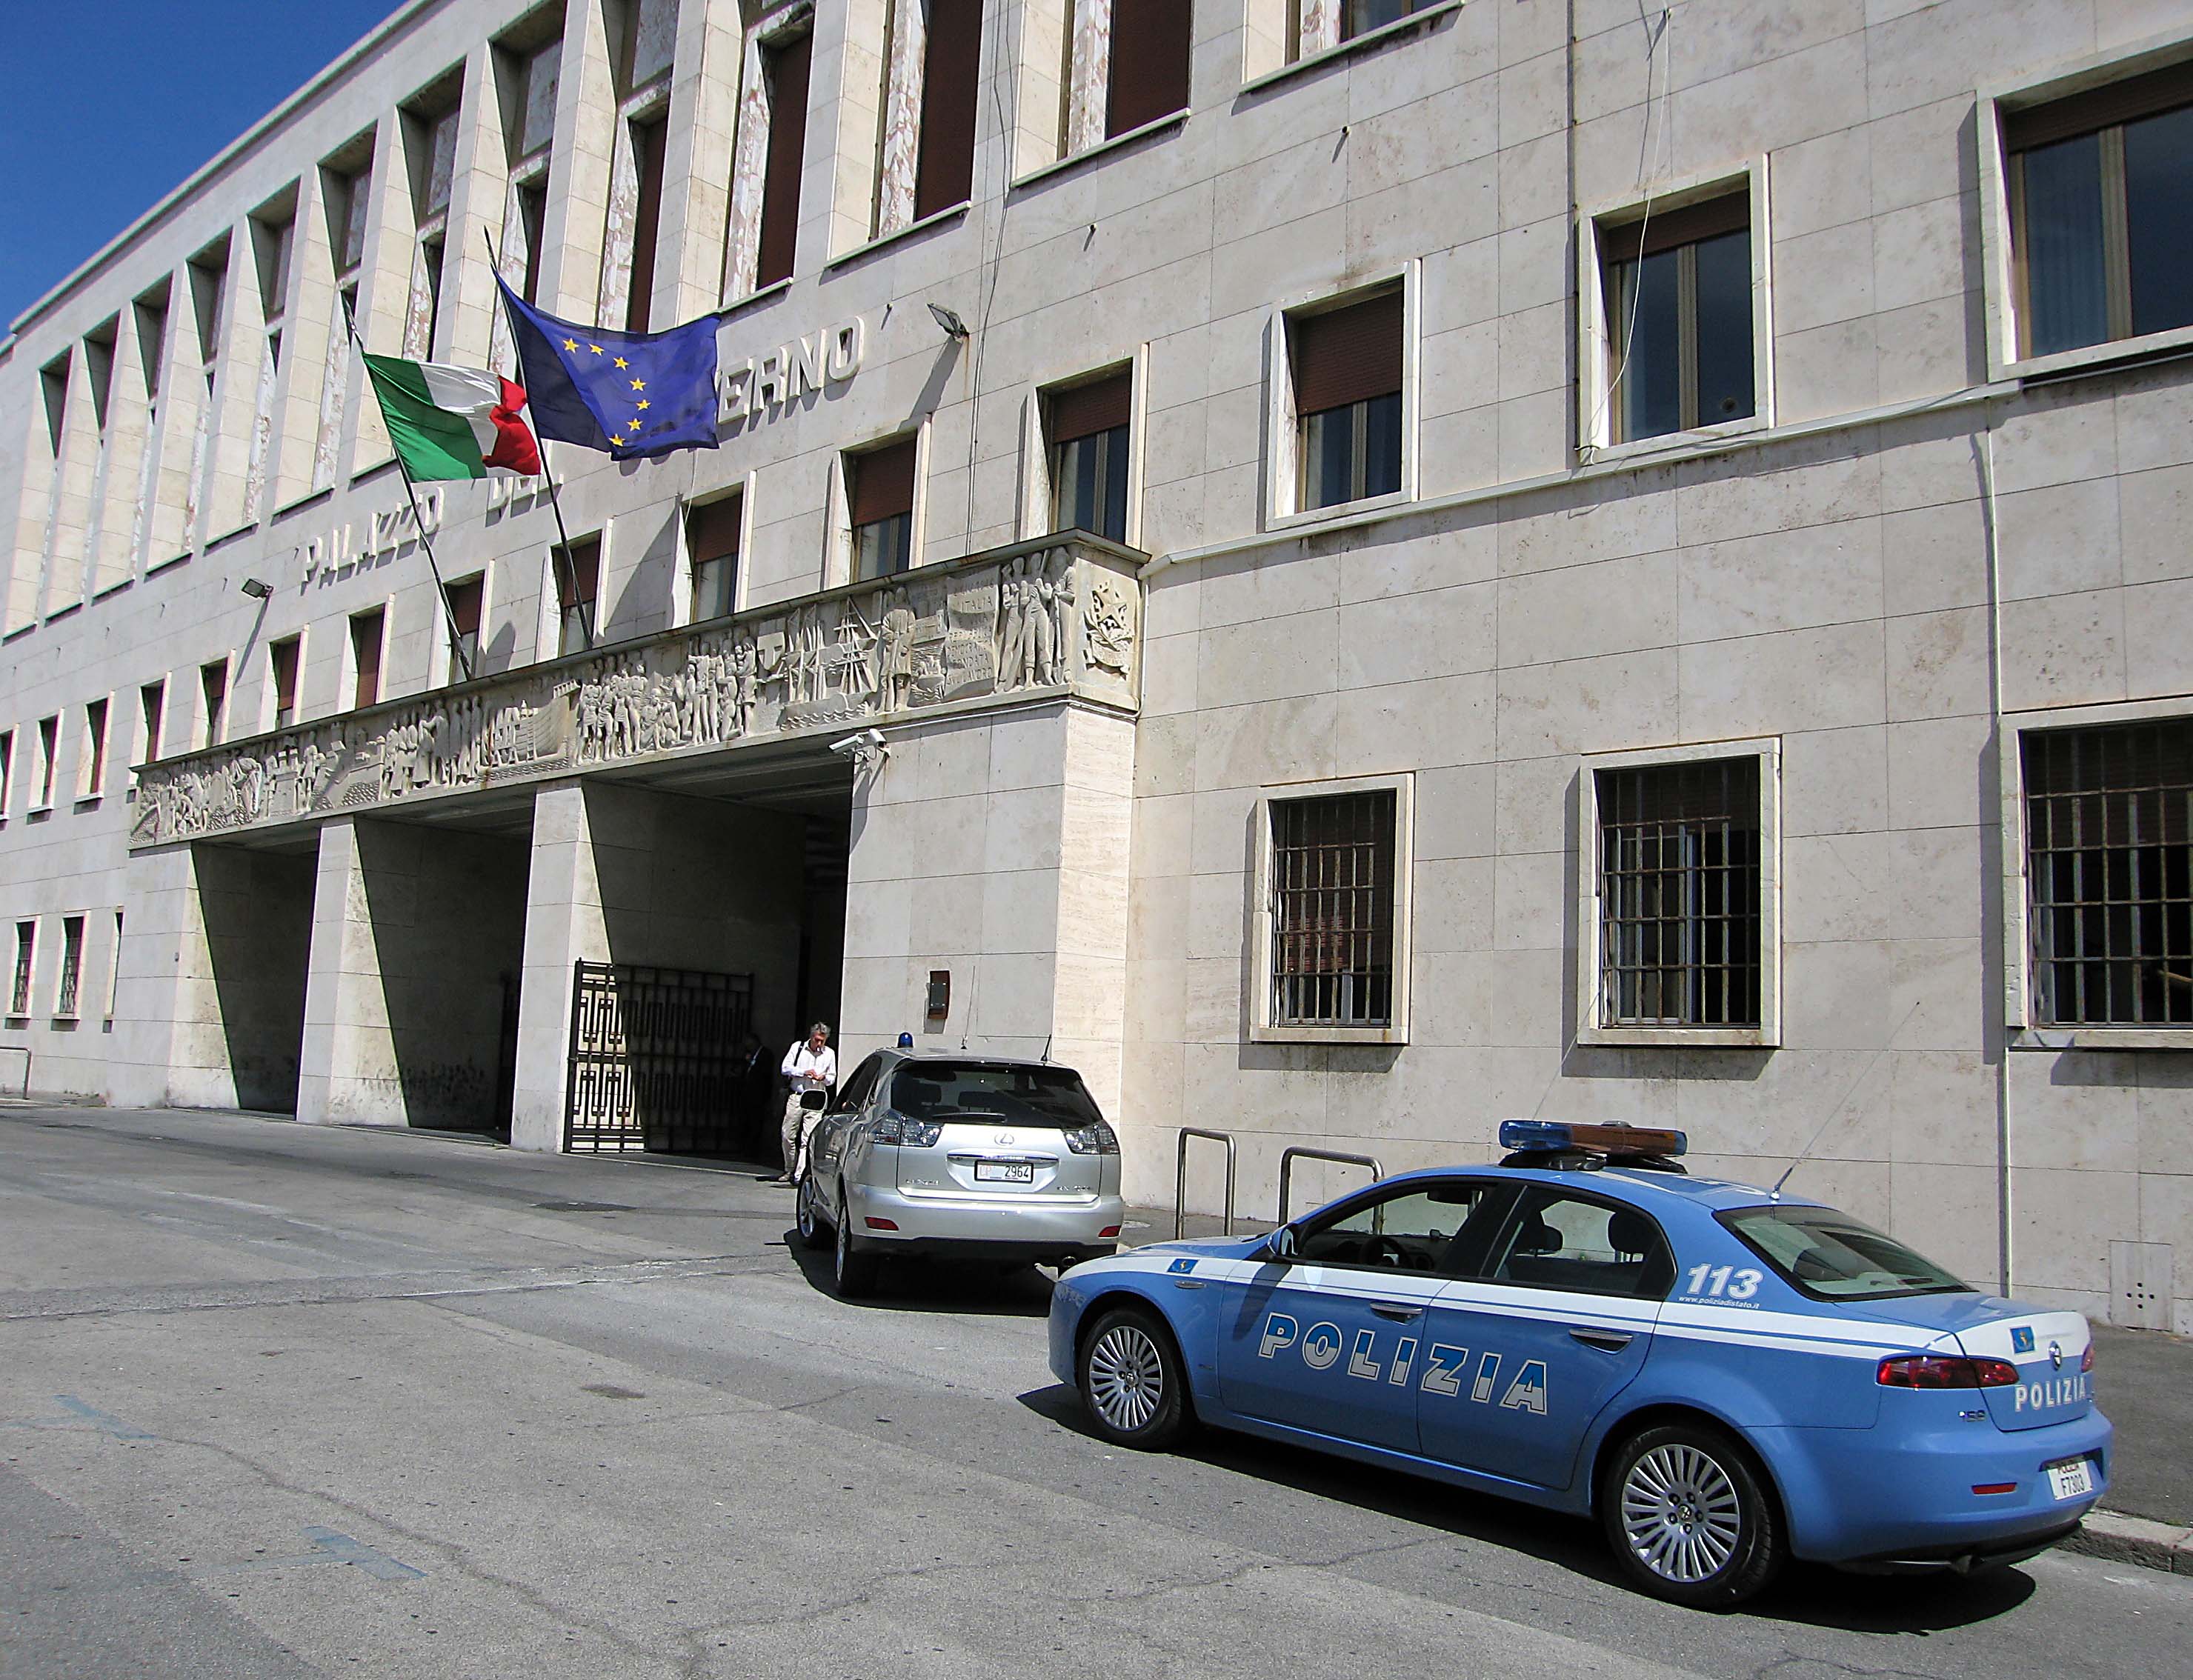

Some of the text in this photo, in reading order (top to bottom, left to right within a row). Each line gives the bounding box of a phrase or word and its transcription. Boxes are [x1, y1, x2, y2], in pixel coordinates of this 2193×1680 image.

[301, 486, 445, 584] PALAZZO
[713, 316, 865, 427] ERNO
[1004, 1165, 1030, 1179] 2964
[1686, 1262, 1764, 1300] 113
[1678, 1296, 1760, 1310] www.poliziadistato.it
[1259, 1311, 1548, 1416] POLIZIA
[2014, 1376, 2087, 1413] POLIZIA
